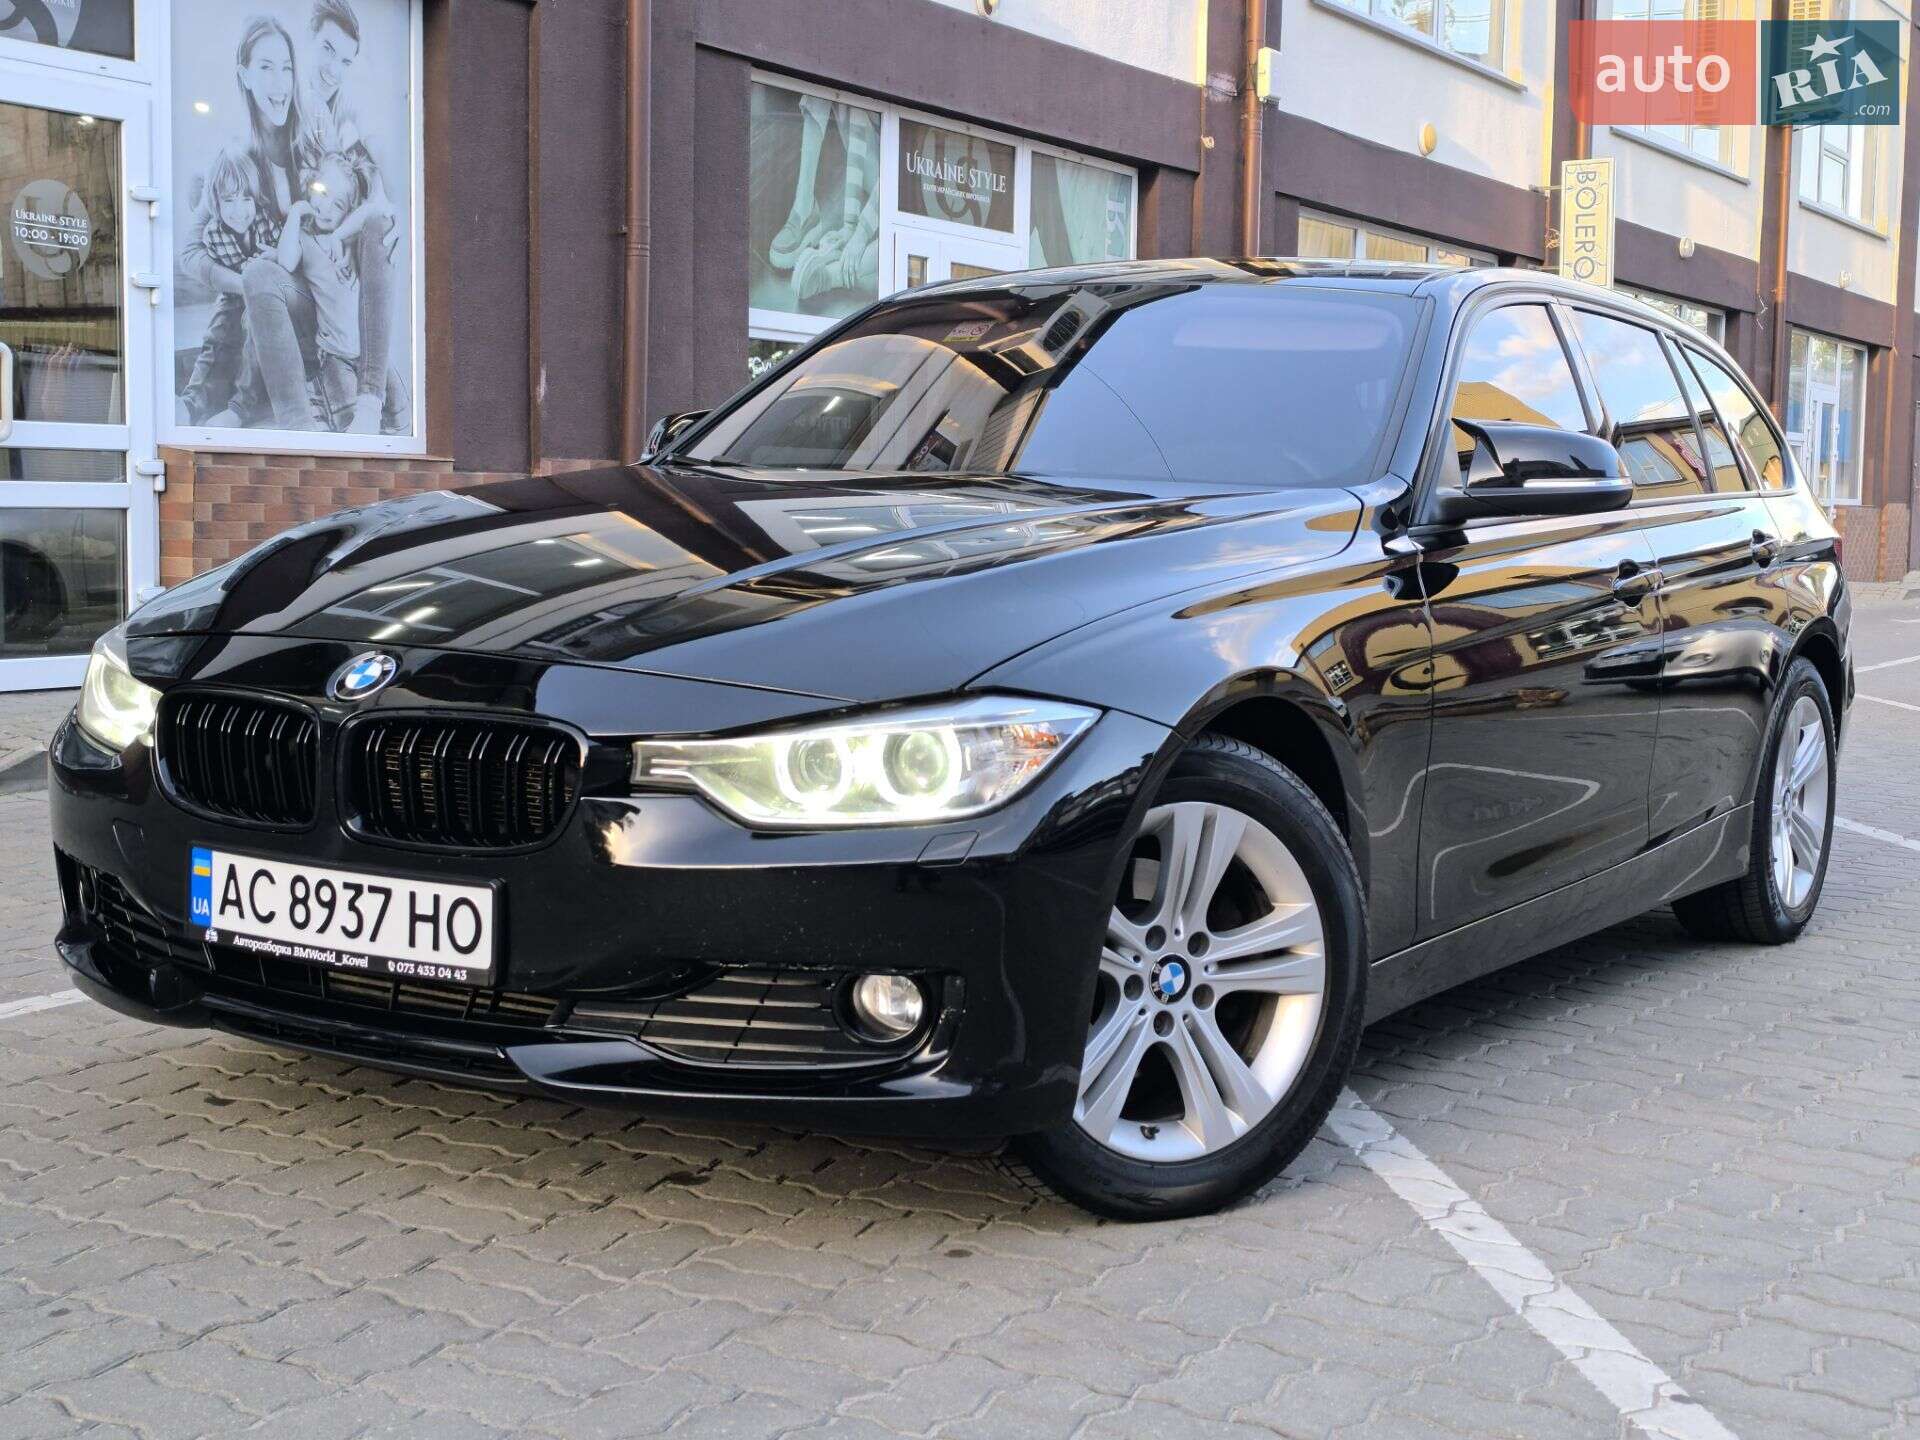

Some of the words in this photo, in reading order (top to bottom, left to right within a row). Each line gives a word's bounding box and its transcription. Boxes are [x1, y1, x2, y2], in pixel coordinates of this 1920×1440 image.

[969, 168, 1006, 193] STYLE
[15, 209, 58, 224] UKRAINE
[60, 216, 87, 228] STYLE
[1574, 170, 1597, 279] BOLERO
[15, 226, 48, 241] 10:00
[58, 232, 88, 246] 19:00
[193, 896, 210, 915] UA
[219, 863, 276, 924] AC
[289, 874, 393, 942] 8937
[408, 891, 482, 955] HO
[293, 946, 369, 969] BMWorld_Kovel
[396, 961, 415, 974] 073
[417, 964, 436, 977] 433
[438, 967, 451, 979] 04
[454, 969, 467, 980] 43
